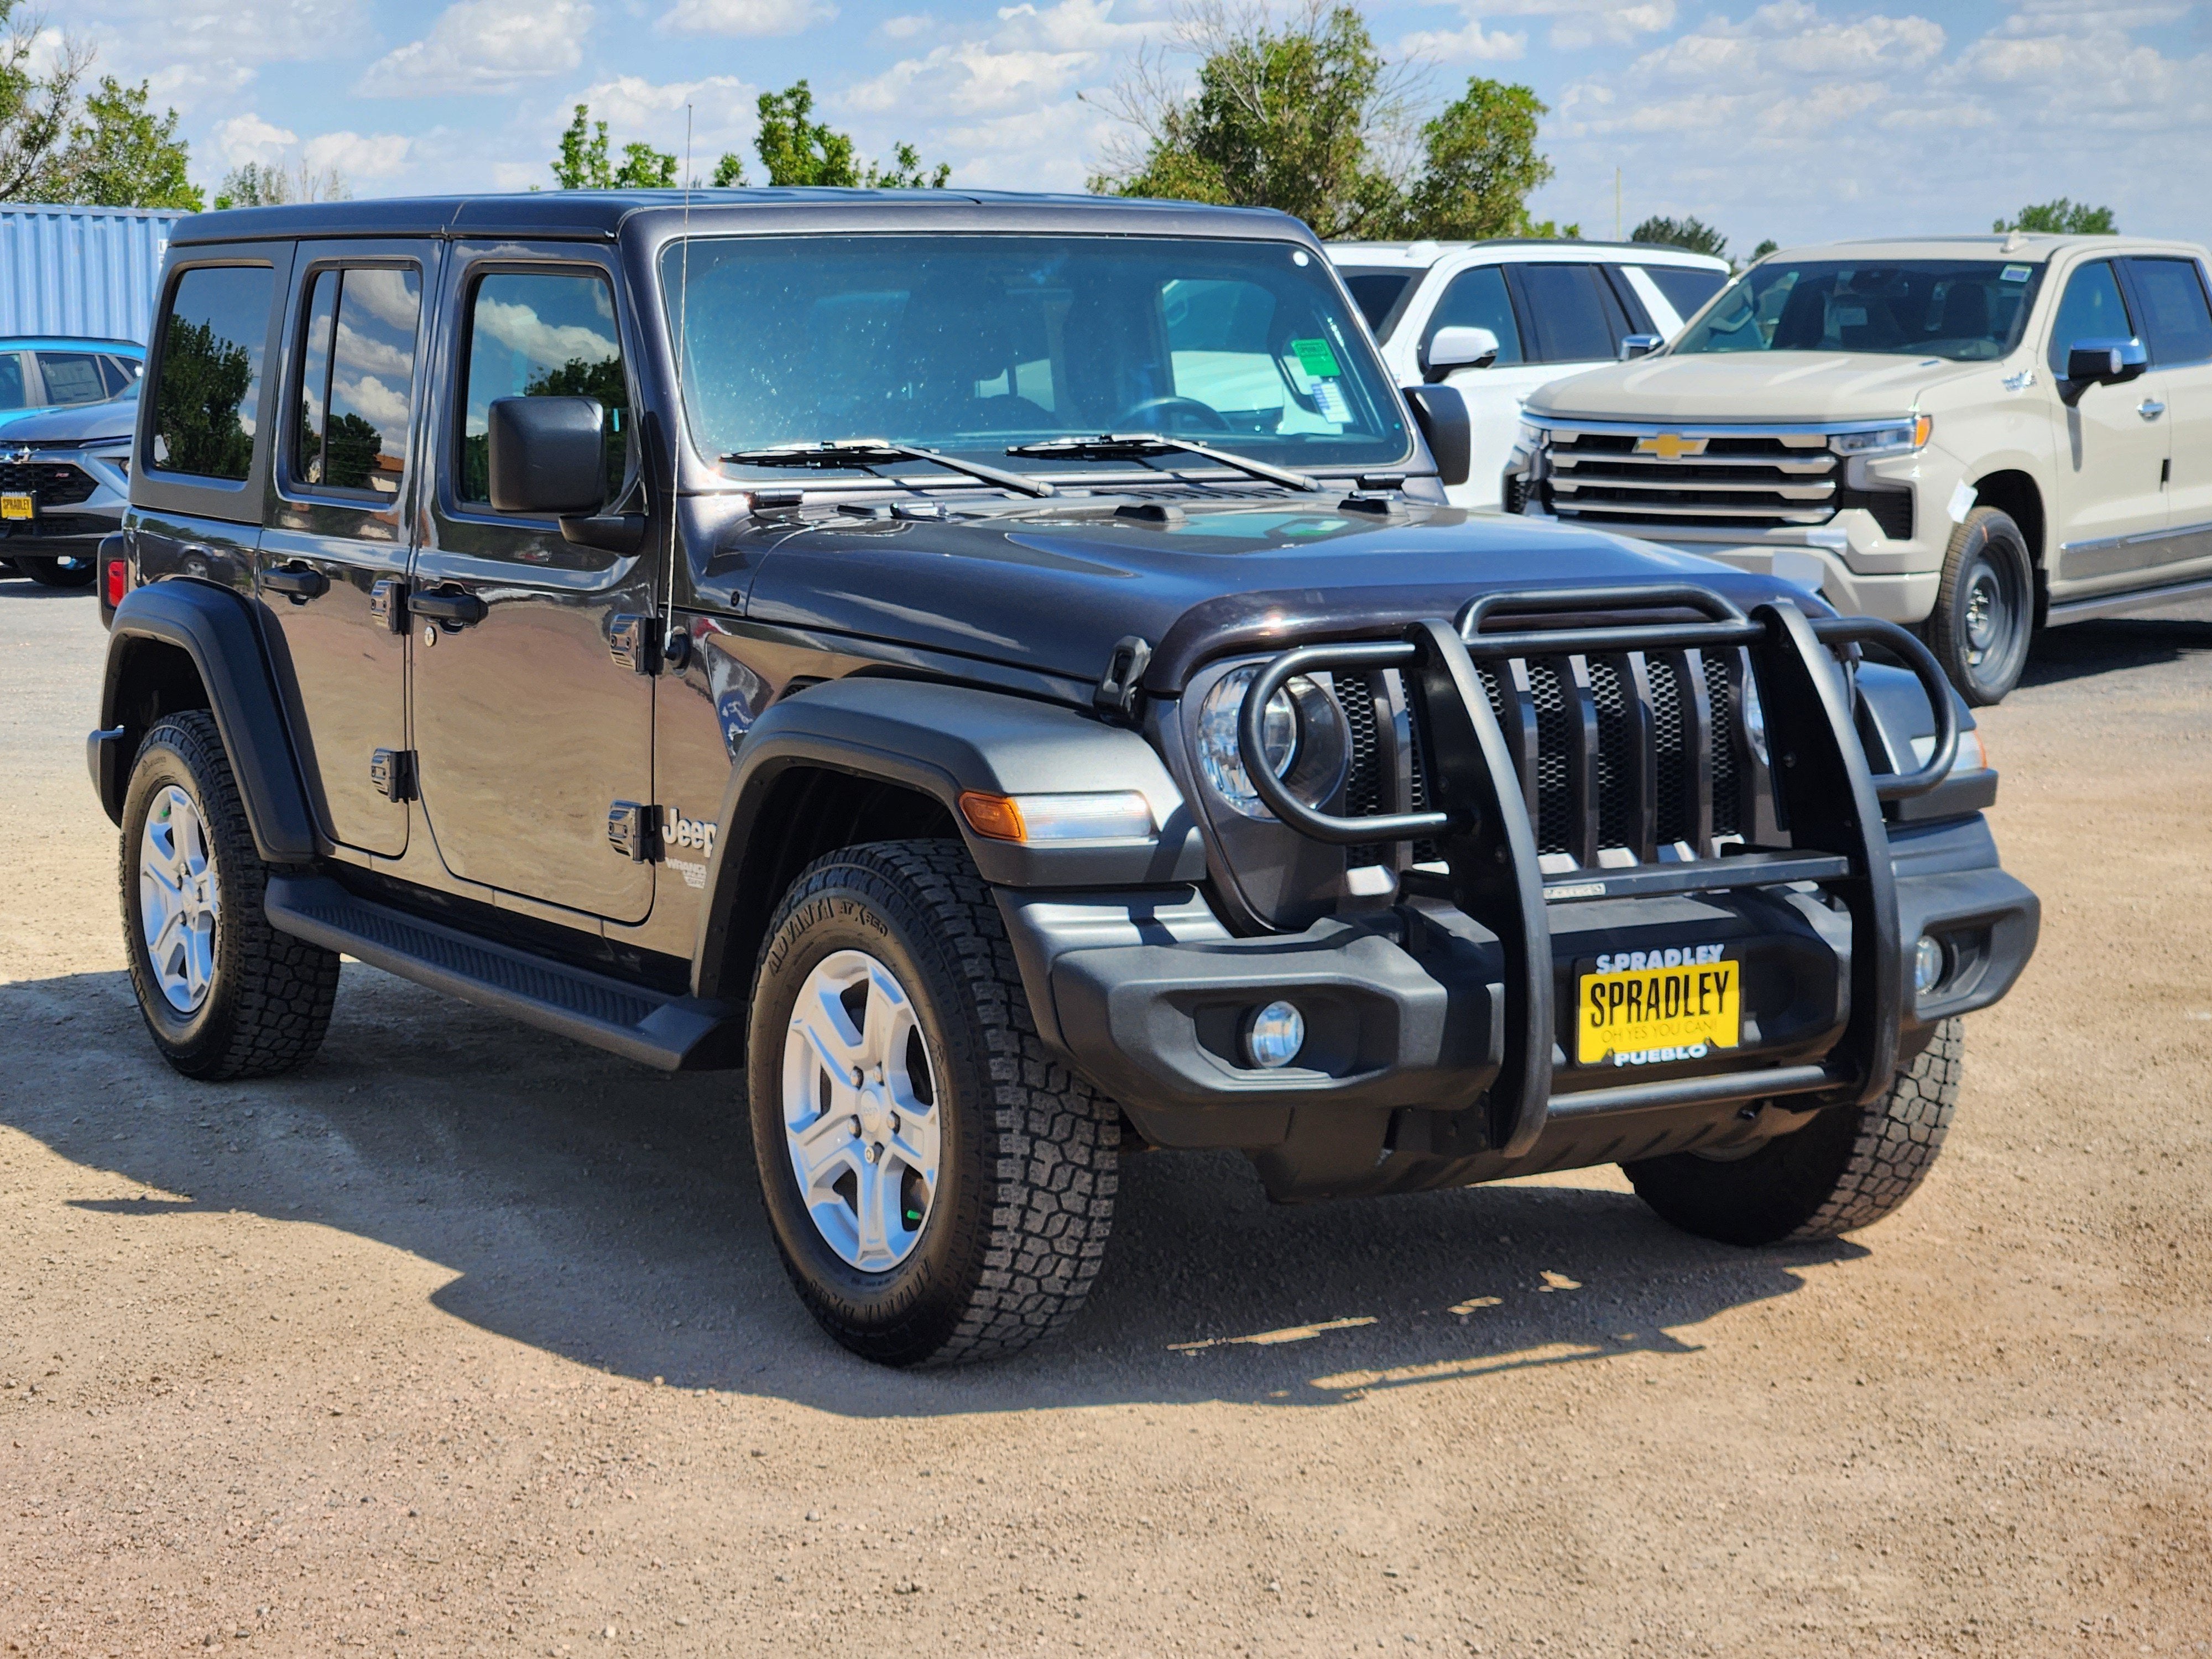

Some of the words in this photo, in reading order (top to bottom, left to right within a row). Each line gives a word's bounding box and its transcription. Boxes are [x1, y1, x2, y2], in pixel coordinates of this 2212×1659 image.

[662, 807, 717, 858] Jeep
[1590, 971, 1729, 1029] SPRADLEY
[1626, 1025, 1647, 1041] YES
[1650, 1021, 1681, 1039] YOU
[1614, 1043, 1708, 1067] PUEBLO
